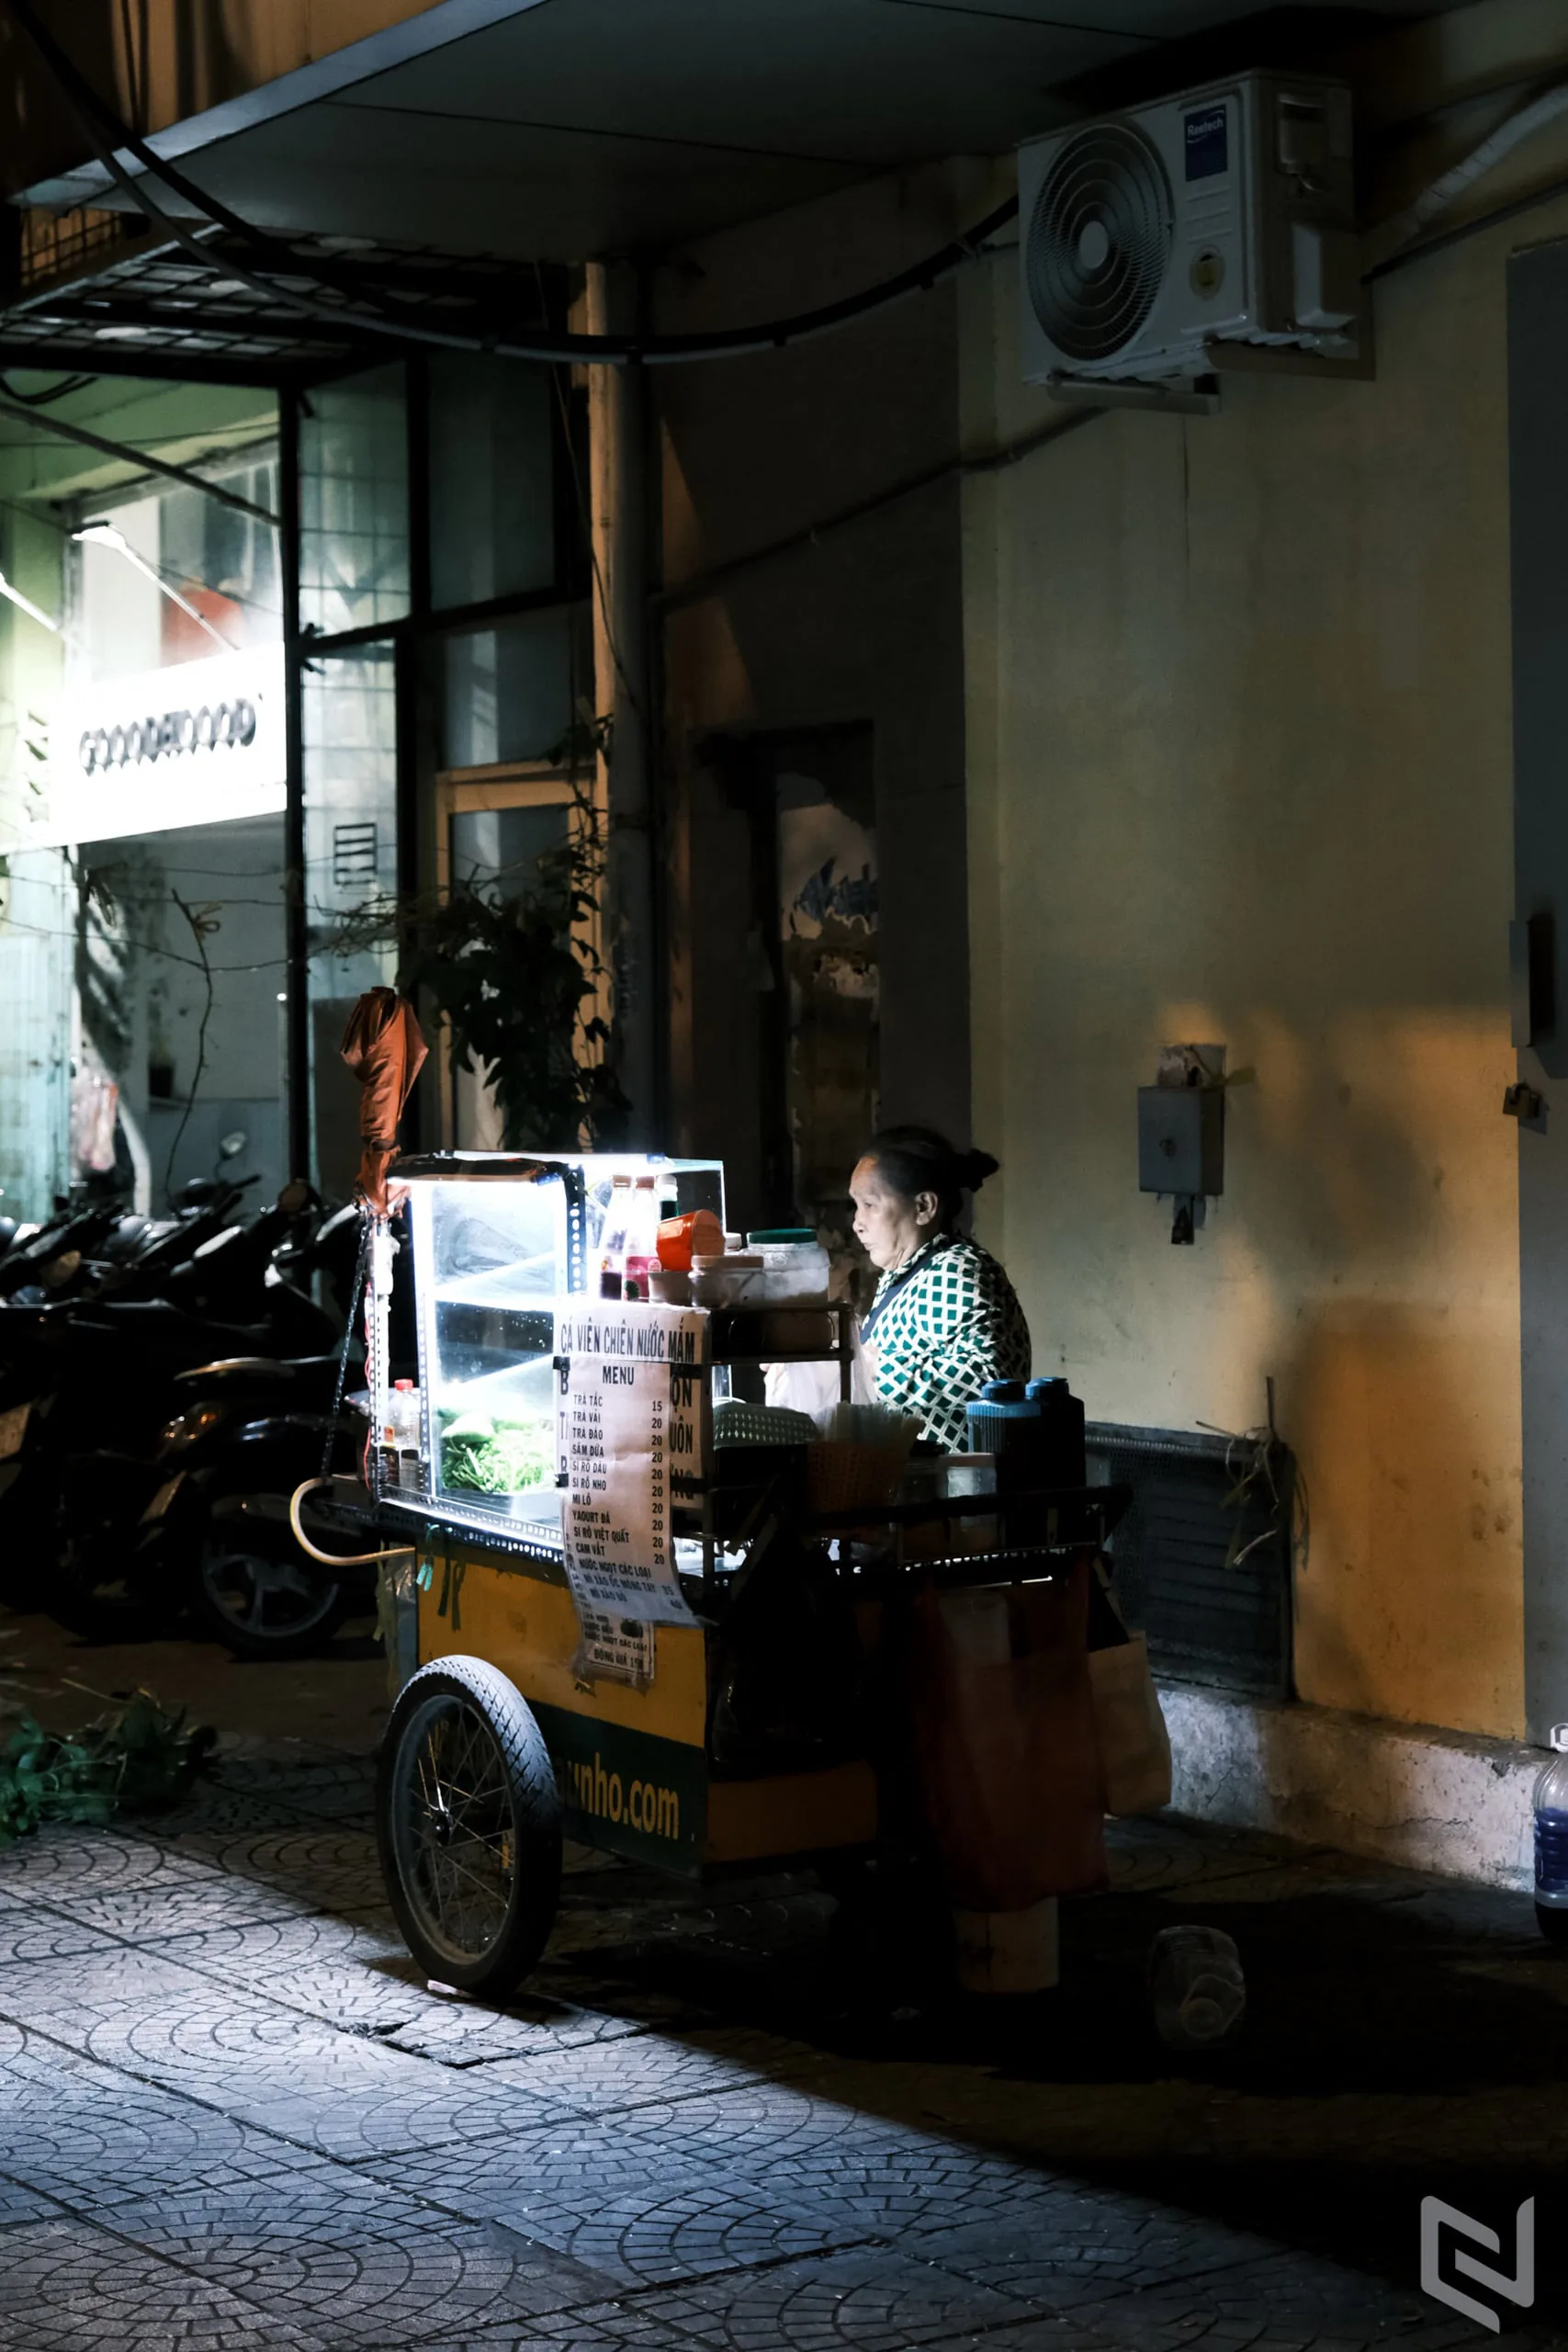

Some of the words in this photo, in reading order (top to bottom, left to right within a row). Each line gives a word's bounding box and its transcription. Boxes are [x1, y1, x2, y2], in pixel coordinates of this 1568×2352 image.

[560, 1315, 573, 1354] CÁ
[577, 1316, 601, 1352] VIÊN
[604, 1319, 633, 1356] CHIÊN
[637, 1320, 664, 1358] NƯỚC
[668, 1317, 694, 1363] MẮM
[603, 1365, 634, 1385] MENU
[652, 1400, 662, 1411] 15
[651, 1418, 661, 1429] 20
[651, 1435, 661, 1445] 20
[651, 1453, 662, 1463] 20
[651, 1469, 662, 1479] 20
[592, 1478, 606, 1490] NHO
[651, 1487, 662, 1497] 20
[652, 1503, 662, 1513] 20
[572, 1510, 598, 1522] YAOURT
[652, 1520, 663, 1531] 20
[594, 1526, 609, 1542] VIỆT
[612, 1528, 629, 1544] QUẤT
[652, 1537, 663, 1547] 20
[576, 1543, 591, 1553] CAM
[654, 1554, 664, 1565] 20
[598, 1561, 616, 1574] NGỌT
[619, 1562, 634, 1577] CÁC
[634, 1566, 651, 1580] LOẠI
